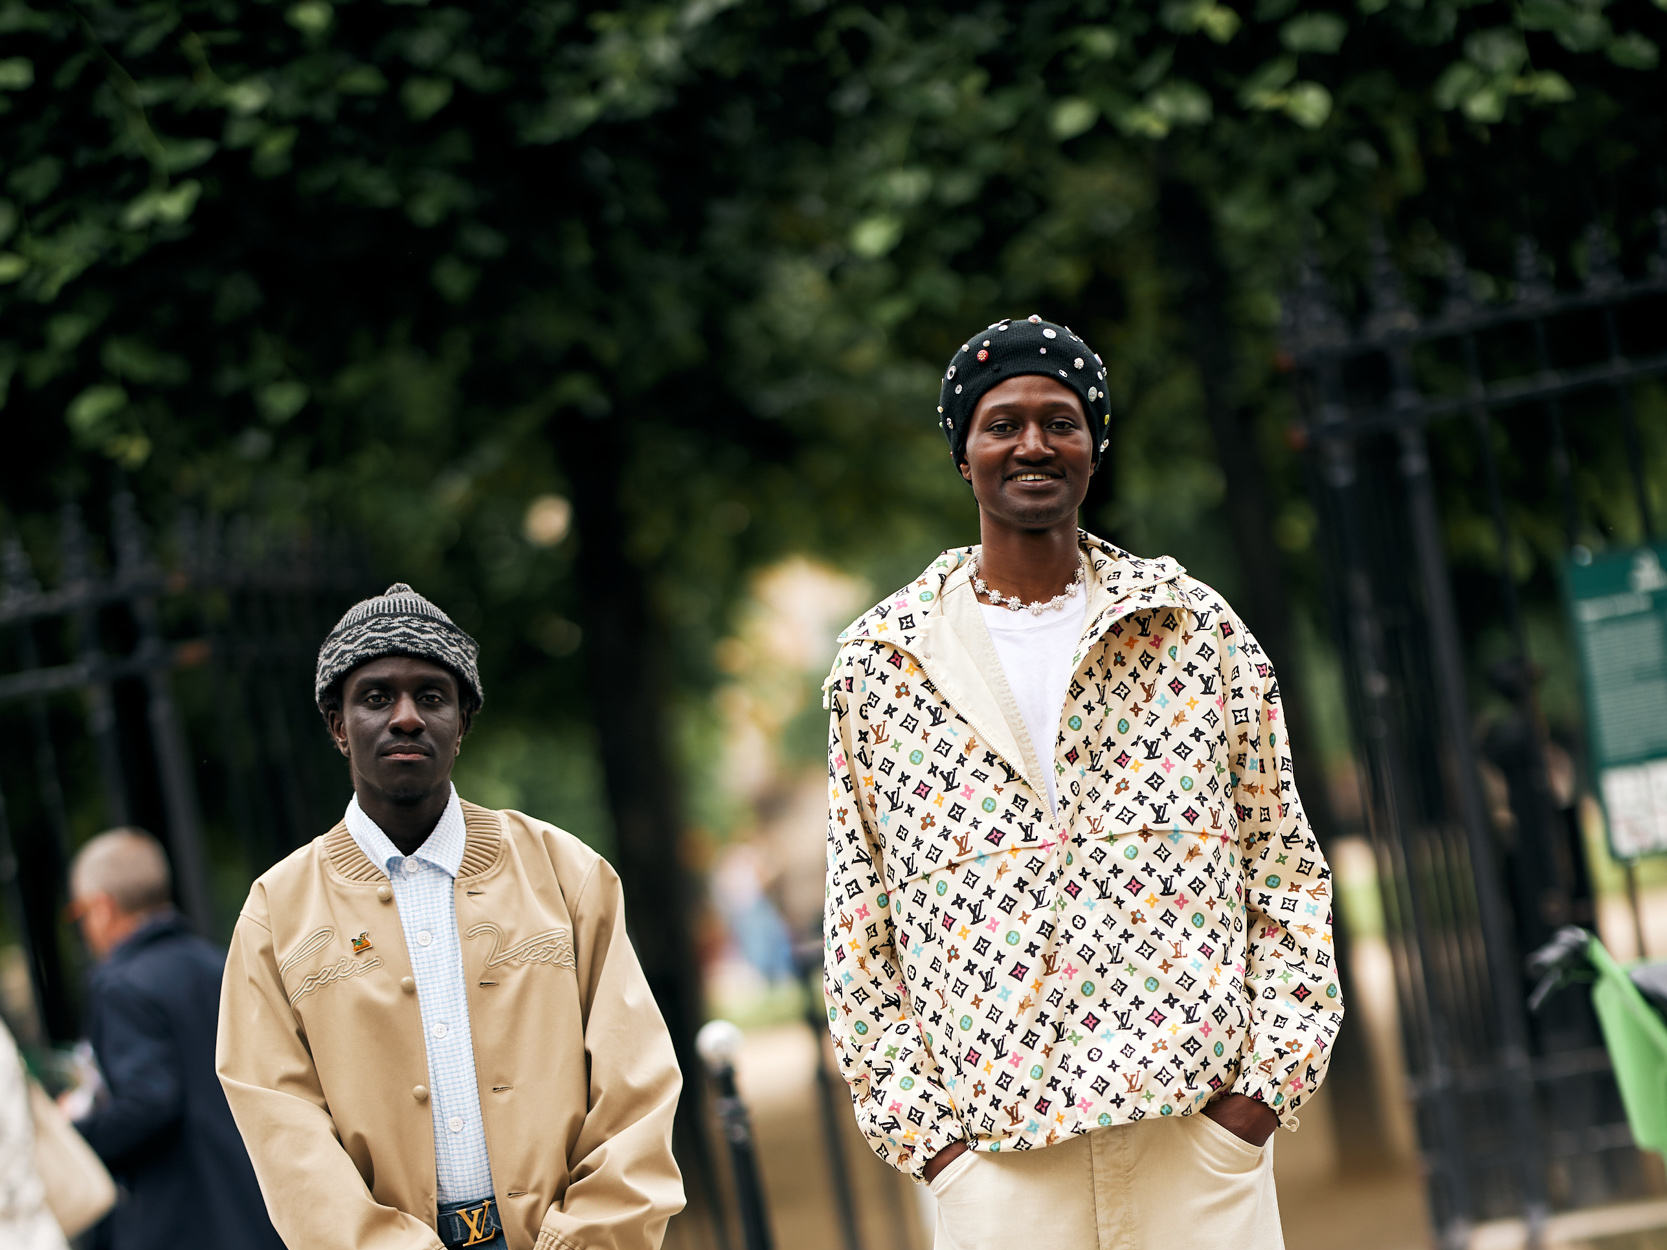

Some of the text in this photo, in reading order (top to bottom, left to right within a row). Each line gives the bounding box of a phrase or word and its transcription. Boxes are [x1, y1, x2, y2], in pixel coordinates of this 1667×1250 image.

[1134, 615, 1152, 637] LV
[1191, 611, 1213, 632] LV
[858, 654, 876, 677] LV
[1139, 678, 1157, 703] LV
[1198, 674, 1216, 695] LV
[926, 706, 947, 727] LV
[869, 720, 890, 745] LV
[1142, 738, 1162, 760] LV
[1204, 740, 1218, 763] LV
[1086, 750, 1103, 772] LV
[939, 767, 961, 792] LV
[884, 787, 904, 812] LV
[1085, 815, 1105, 834] LV
[1149, 803, 1170, 824] LV
[1208, 807, 1223, 829] LV
[1017, 822, 1038, 842] LV
[1280, 825, 1304, 850] LV
[952, 832, 973, 857] LV
[851, 845, 872, 870] LV
[900, 852, 918, 877] LV
[1092, 877, 1113, 900] LV
[1157, 874, 1177, 896] LV
[1214, 877, 1229, 900] LV
[1306, 881, 1330, 901] LV
[1028, 886, 1051, 910] LV
[839, 909, 854, 934] LV
[967, 899, 987, 925] LV
[917, 918, 937, 944] LV
[1104, 943, 1124, 964] LV
[1167, 940, 1188, 959] LV
[1041, 951, 1061, 977] LV
[978, 967, 997, 993] LV
[1112, 1009, 1134, 1031] LV
[1179, 1003, 1201, 1024] LV
[990, 1034, 1009, 1060] LV
[872, 1060, 895, 1086] LV
[1122, 1070, 1143, 1093] LV
[1183, 1069, 1199, 1090] LV
[879, 1115, 902, 1134] LV
[1003, 1101, 1024, 1126] LV
[457, 1200, 495, 1247] LV
